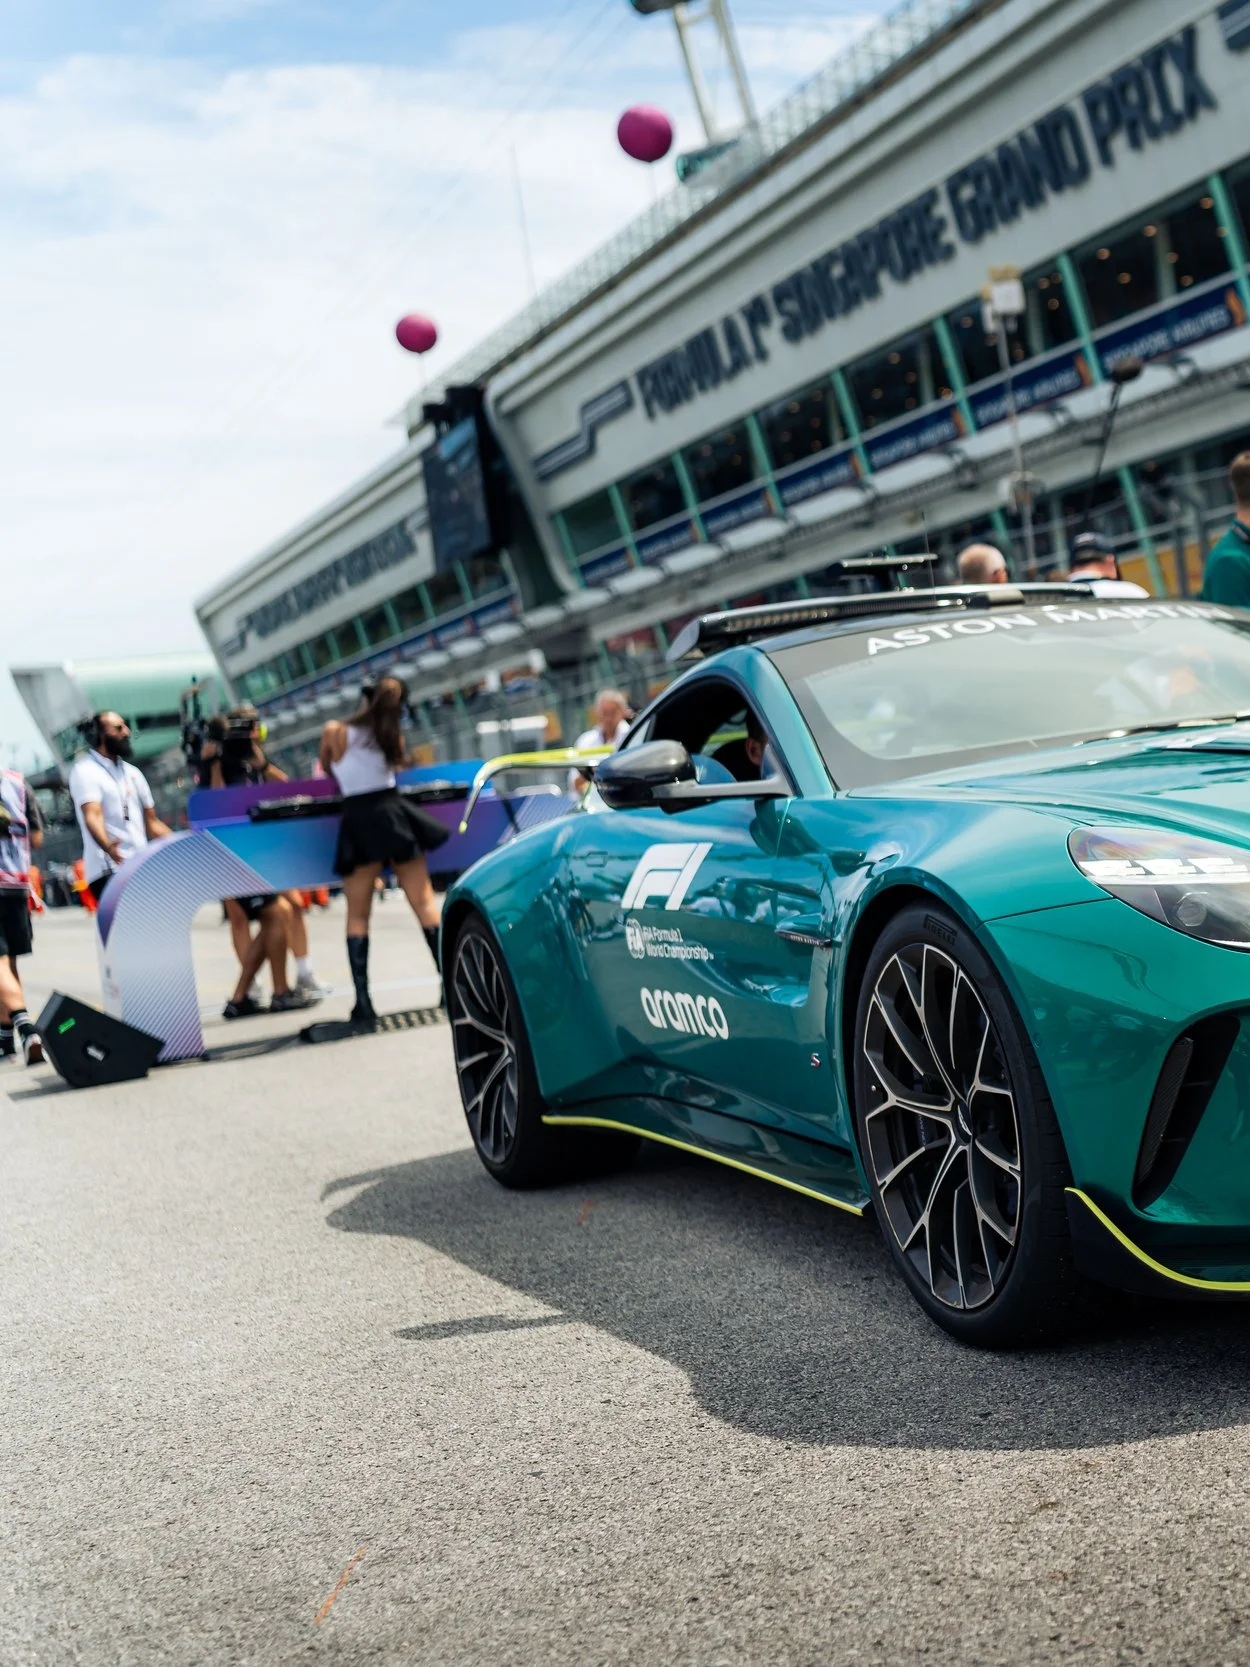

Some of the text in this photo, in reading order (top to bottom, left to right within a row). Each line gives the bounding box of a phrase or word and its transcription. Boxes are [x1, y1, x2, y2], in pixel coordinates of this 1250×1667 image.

[772, 186, 956, 344] SINGAPORE
[945, 102, 1091, 244] GRAND
[1082, 21, 1219, 168] PRIX
[867, 604, 1235, 656] ASTON MARTIN
[621, 842, 713, 910] F1
[653, 927, 680, 942] Formula
[664, 944, 710, 962] Championship
[640, 986, 729, 1040] aramco
[810, 1053, 821, 1067] S
